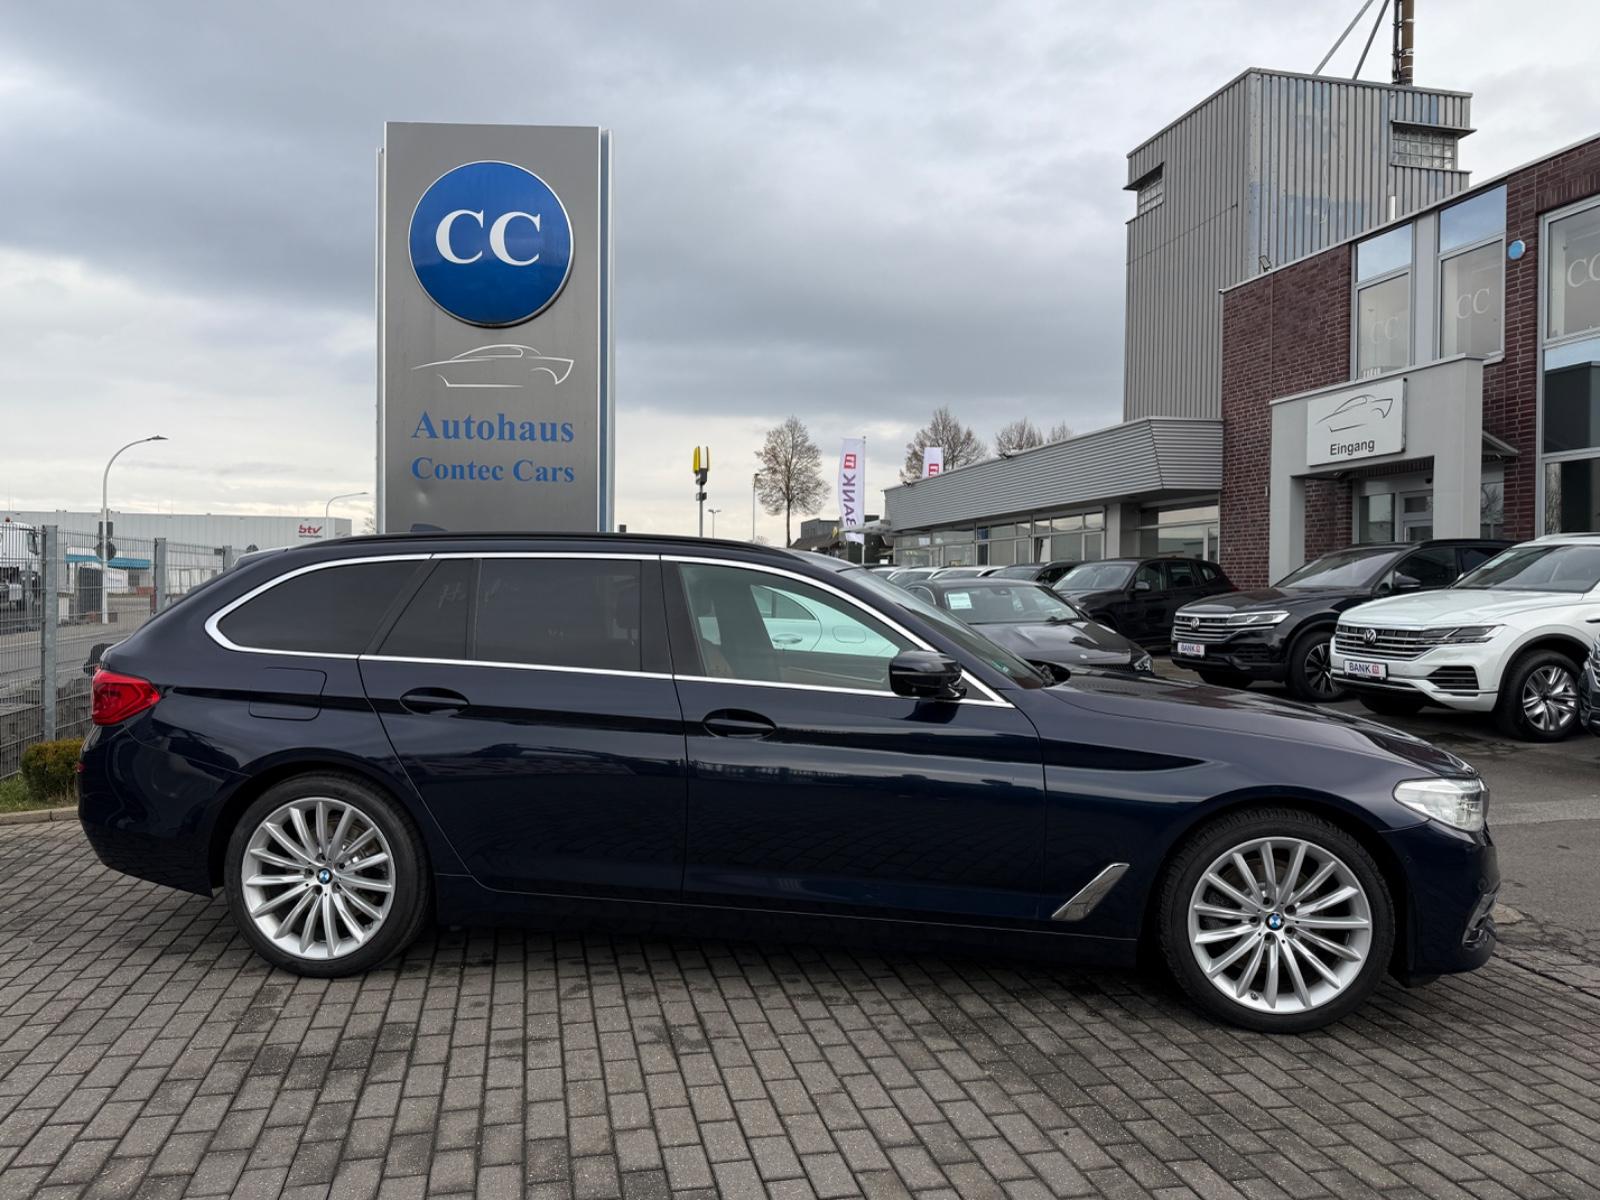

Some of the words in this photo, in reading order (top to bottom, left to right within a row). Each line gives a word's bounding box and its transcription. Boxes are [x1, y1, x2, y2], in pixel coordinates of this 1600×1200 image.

[435, 208, 541, 267] CC
[1456, 288, 1490, 319] CC
[411, 410, 575, 442] Autohaus
[1330, 440, 1375, 456] Eingang
[411, 456, 504, 481] Contec
[512, 459, 575, 483] Cars
[298, 524, 322, 534] btv
[1349, 662, 1371, 673] BANK
